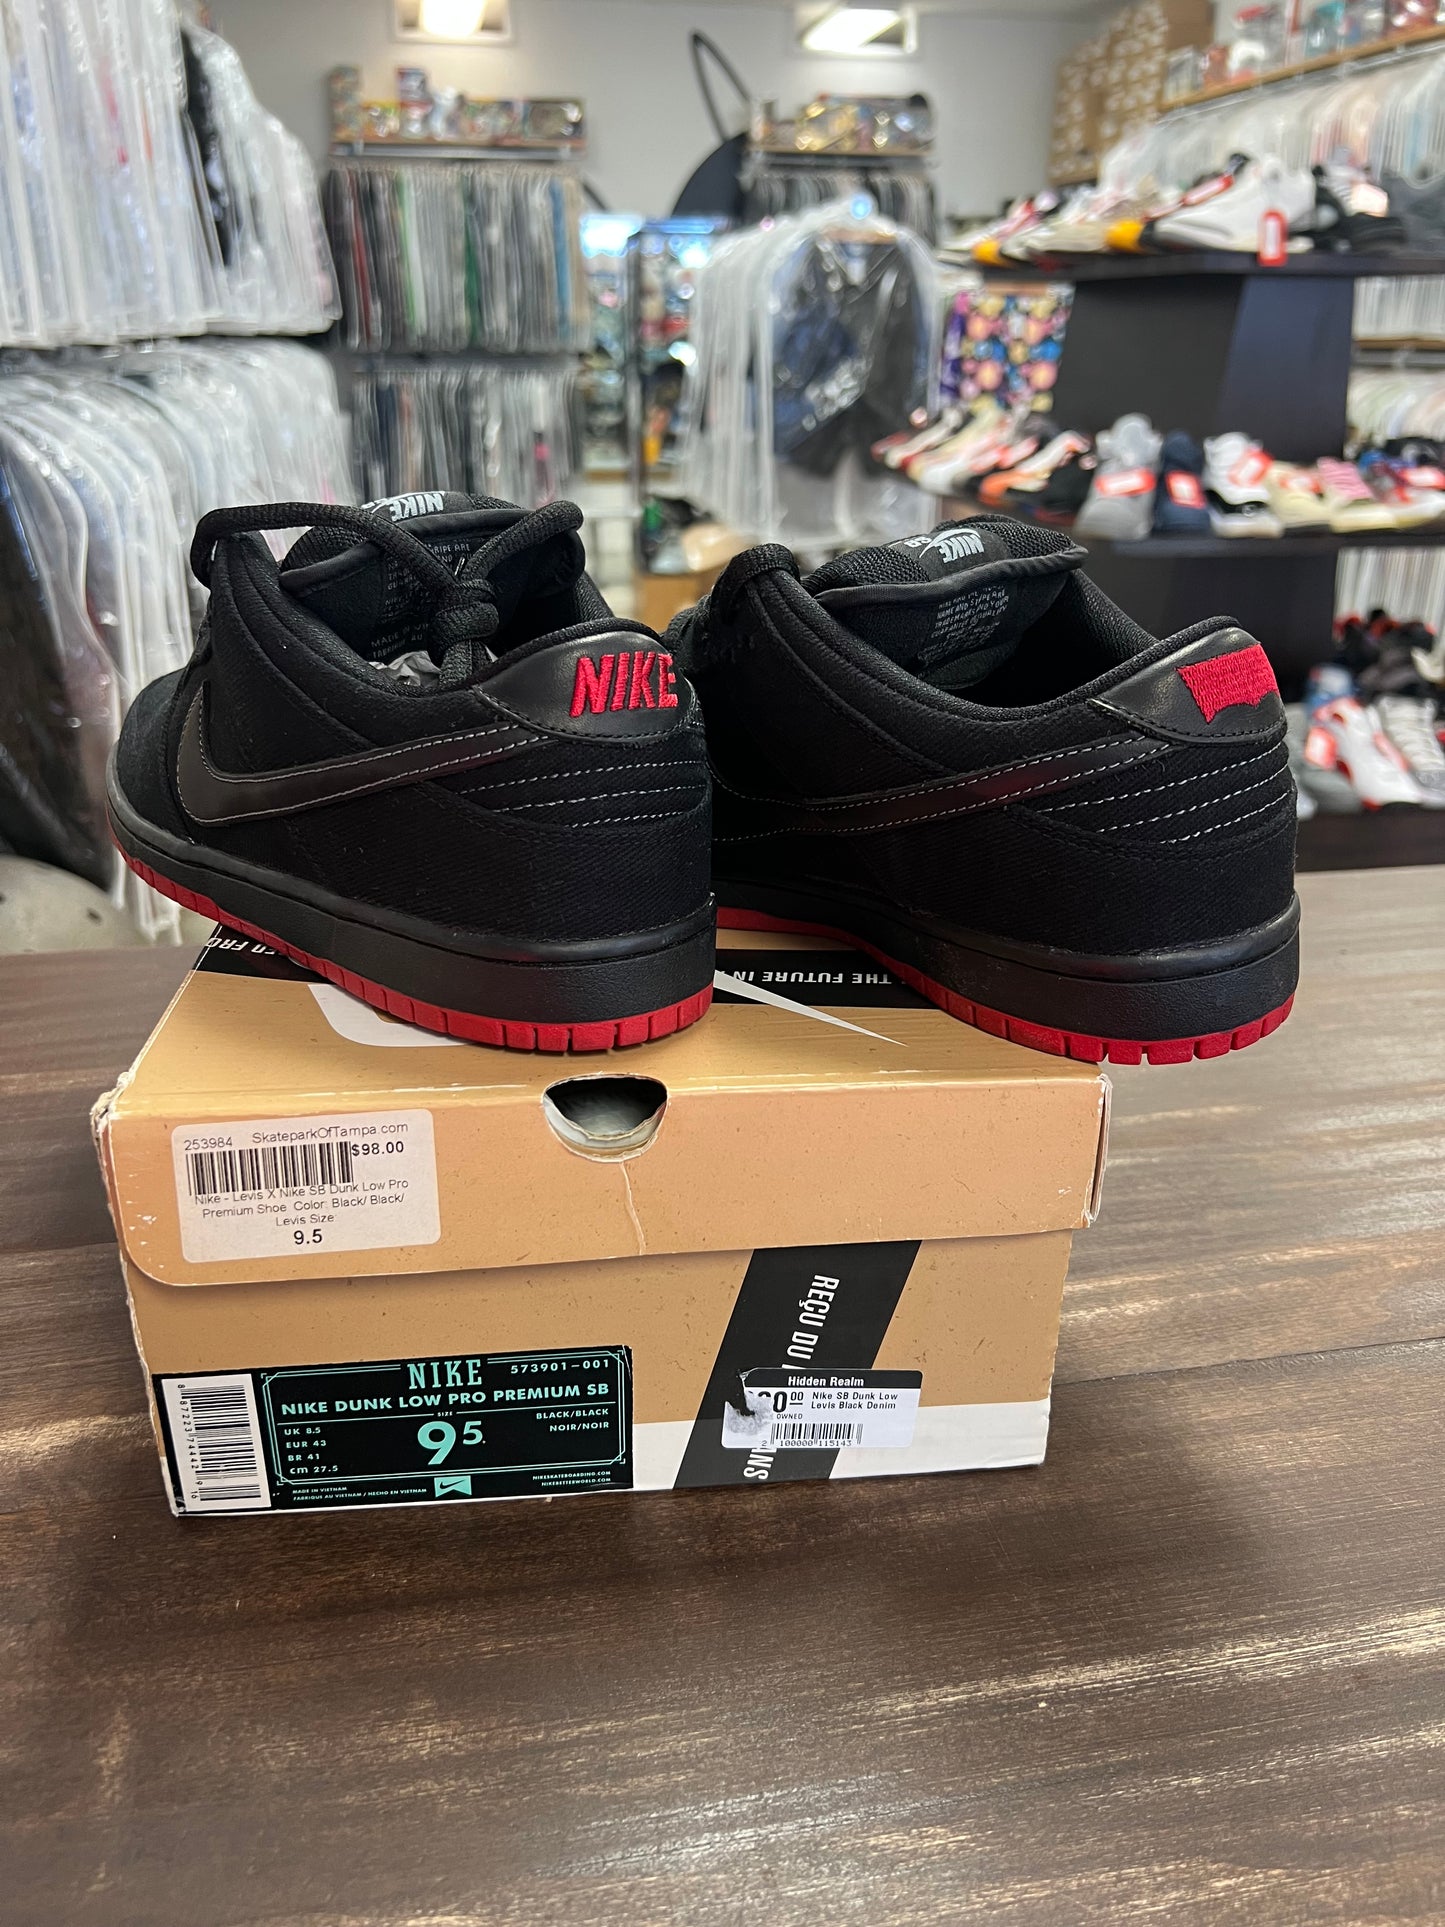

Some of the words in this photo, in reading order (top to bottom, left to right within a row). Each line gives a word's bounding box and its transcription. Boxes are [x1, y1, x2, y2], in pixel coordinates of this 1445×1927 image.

[389, 493, 444, 521] NIKE
[938, 534, 985, 563] NIKE
[569, 651, 679, 718] NIKE
[762, 971, 843, 984] FUTURE
[852, 973, 892, 985] THE
[184, 1136, 233, 1151] 253984
[352, 1141, 404, 1157] $98.00
[195, 1195, 222, 1205] Nike
[233, 1191, 264, 1202] Levis
[267, 1188, 277, 1199] X
[280, 1187, 306, 1198] Nike
[309, 1185, 326, 1195] SB
[330, 1183, 359, 1194] Dunk
[362, 1181, 386, 1192] Low
[388, 1179, 409, 1189] Pro
[202, 1206, 254, 1218] Premium
[257, 1203, 287, 1214] Shoe
[332, 1196, 367, 1208] Black/
[370, 1193, 405, 1205] Black/
[275, 1215, 307, 1227] Levis
[293, 1228, 323, 1245] 9.5
[798, 1274, 840, 1328] REÇU
[786, 1331, 819, 1360] DU
[407, 1358, 482, 1390] NIKE
[510, 1358, 609, 1375] 573901-001
[788, 1375, 827, 1387] Hidden
[829, 1376, 865, 1387] Realm
[281, 1401, 328, 1416] NIKE
[335, 1397, 392, 1413] DUNK
[399, 1394, 441, 1409] LOW
[449, 1391, 486, 1405] PRO
[494, 1385, 580, 1402] PREMIUM
[587, 1382, 609, 1396] SB
[812, 1391, 833, 1400] Nike
[836, 1391, 849, 1400] SB
[853, 1391, 876, 1401] Dunk
[879, 1392, 898, 1401] Low
[811, 1401, 836, 1410] Levis
[839, 1401, 863, 1410] Black
[867, 1401, 897, 1410] Denim
[536, 1408, 609, 1420] BLACK/BLACK
[284, 1428, 300, 1436] UK
[306, 1426, 321, 1434] 8.5
[549, 1421, 609, 1432] NOIR/NOIR
[286, 1441, 308, 1449] EUR
[313, 1439, 327, 1447] 43
[288, 1454, 302, 1462] BR
[307, 1453, 320, 1461] 41
[290, 1466, 308, 1475] cm
[313, 1465, 338, 1474] 27.5
